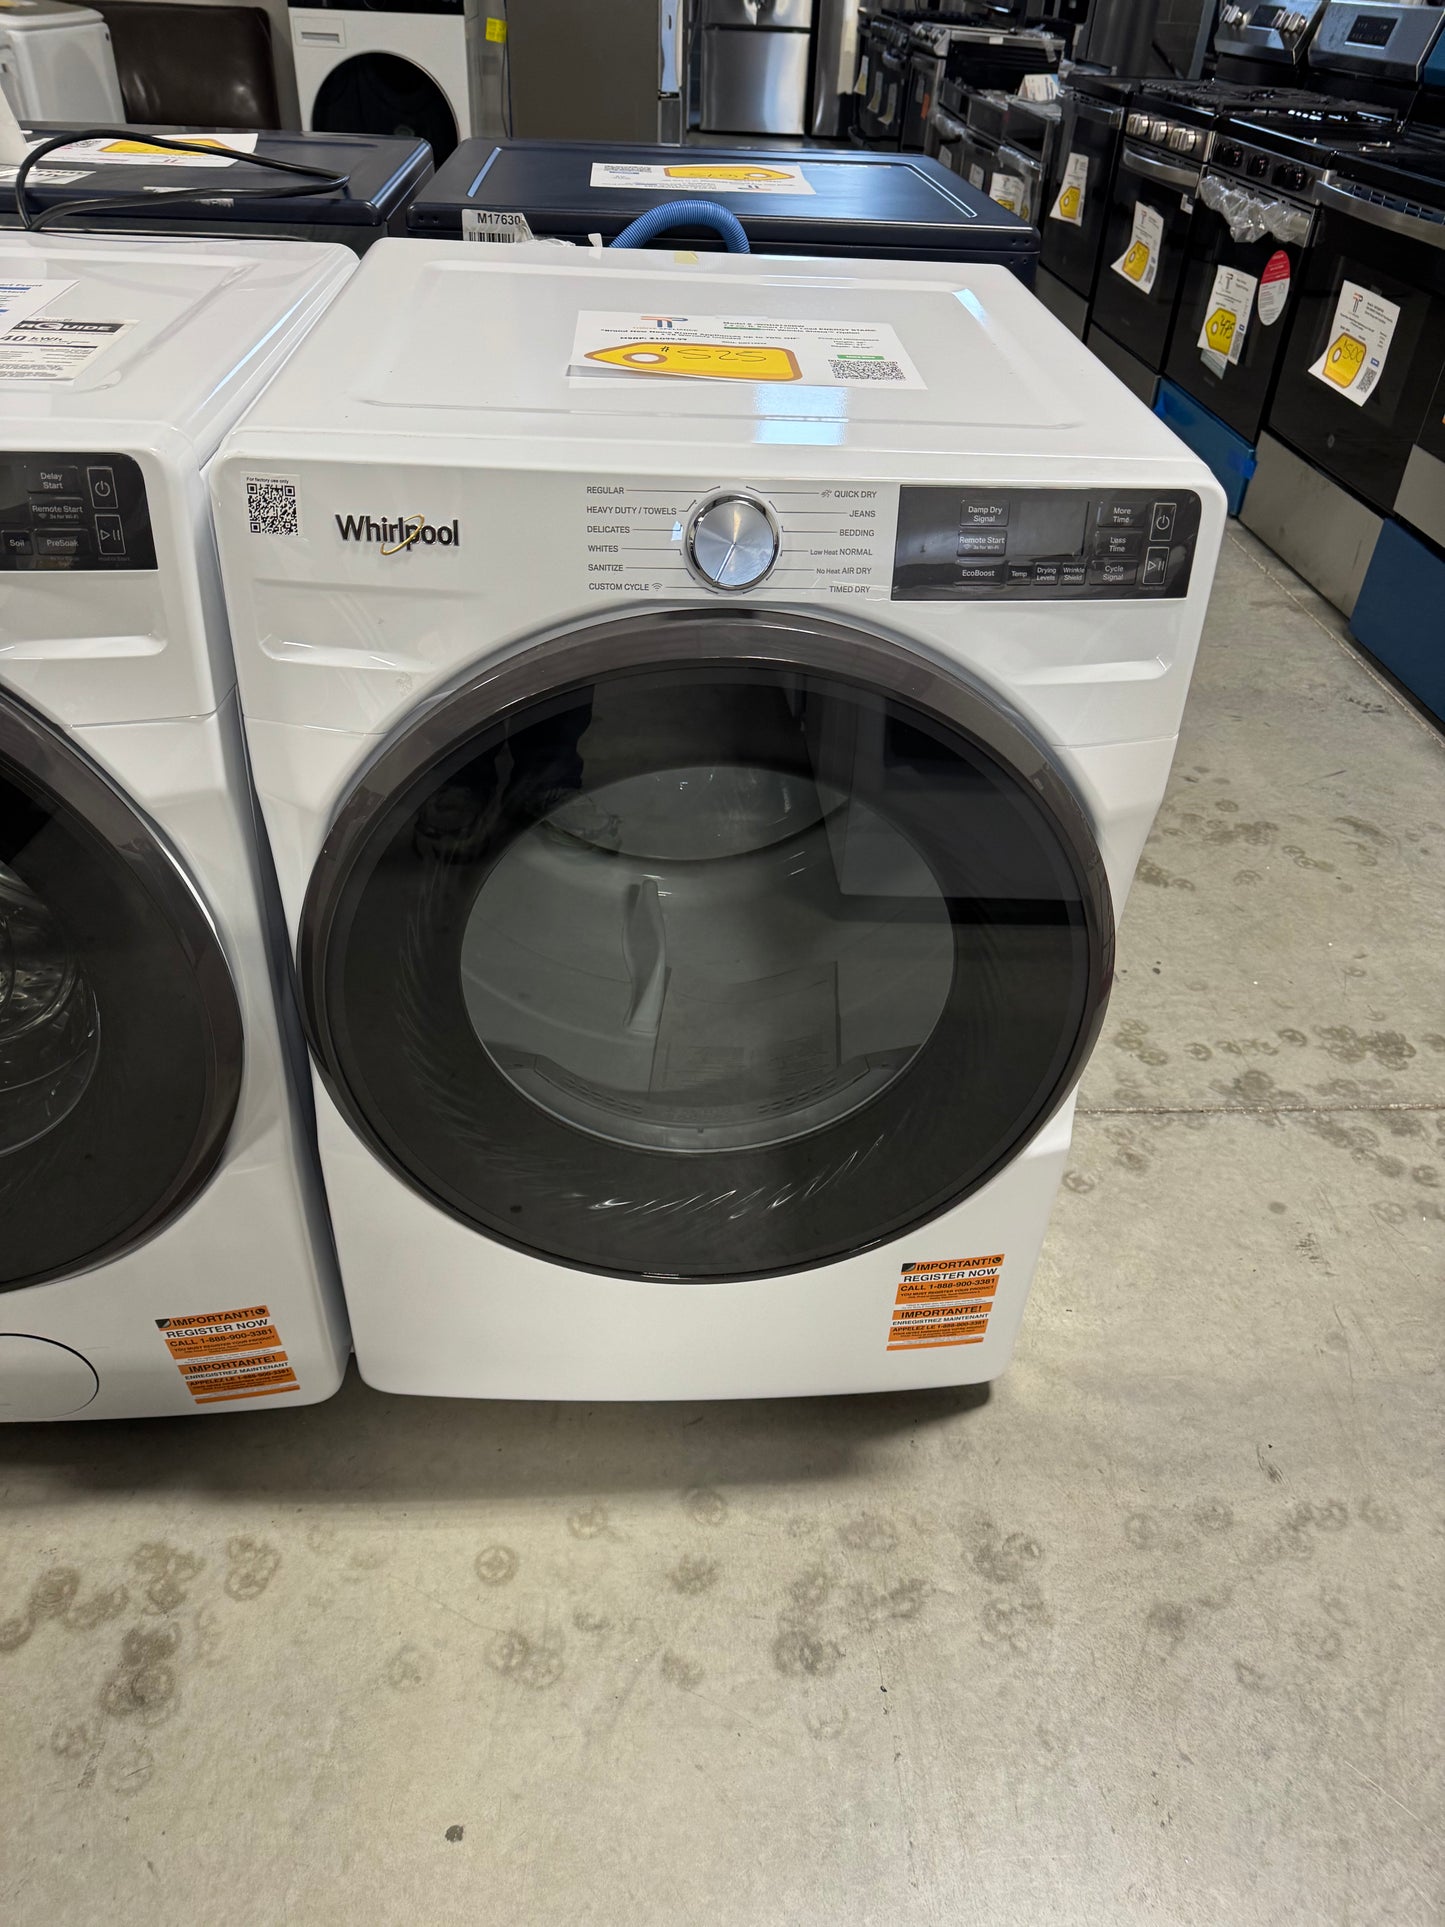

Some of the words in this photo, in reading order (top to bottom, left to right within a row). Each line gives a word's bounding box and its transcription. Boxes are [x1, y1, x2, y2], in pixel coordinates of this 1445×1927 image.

[477, 212, 521, 225] M17630
[15, 322, 113, 331] RGUIDE
[40, 472, 63, 481] Delay
[586, 486, 624, 494] REGULAR
[834, 490, 859, 498] QUICK
[32, 505, 61, 513] Remote
[63, 505, 83, 513] Start
[586, 506, 613, 514] HEAVY
[614, 506, 638, 515] DUTY
[644, 507, 677, 515] TOWELS
[968, 506, 989, 514] Damp
[989, 506, 1003, 514] Dry
[973, 515, 995, 524] Signal
[335, 514, 460, 552] Whirlpool
[839, 529, 875, 537] BEDDING
[46, 539, 79, 547] PreSoak
[839, 548, 873, 556] NORMAL
[962, 569, 995, 577] EcoBoost
[1036, 567, 1056, 575] Drying
[1105, 565, 1124, 573] Cycle
[588, 583, 622, 591] CUSTOM
[624, 583, 649, 591] CYCLE
[829, 585, 853, 593] TIMED
[854, 585, 871, 593] DRY
[917, 1257, 991, 1271] IMPORTANT!
[903, 1270, 965, 1282] REGISTER
[968, 1268, 998, 1277] NOW
[901, 1305, 982, 1318] IMPORTANTE!
[172, 1310, 256, 1327] IMPORTANT!
[892, 1318, 942, 1326] ENREGISTREZ
[943, 1313, 988, 1322] MAINTENANT
[166, 1324, 233, 1338] REGISTER
[236, 1318, 268, 1330] NOW
[169, 1339, 198, 1347] CALL
[188, 1355, 276, 1373] IMPORTANTE!
[185, 1369, 238, 1381] ENREGISTREZ
[239, 1362, 289, 1373] MAINTENANT
